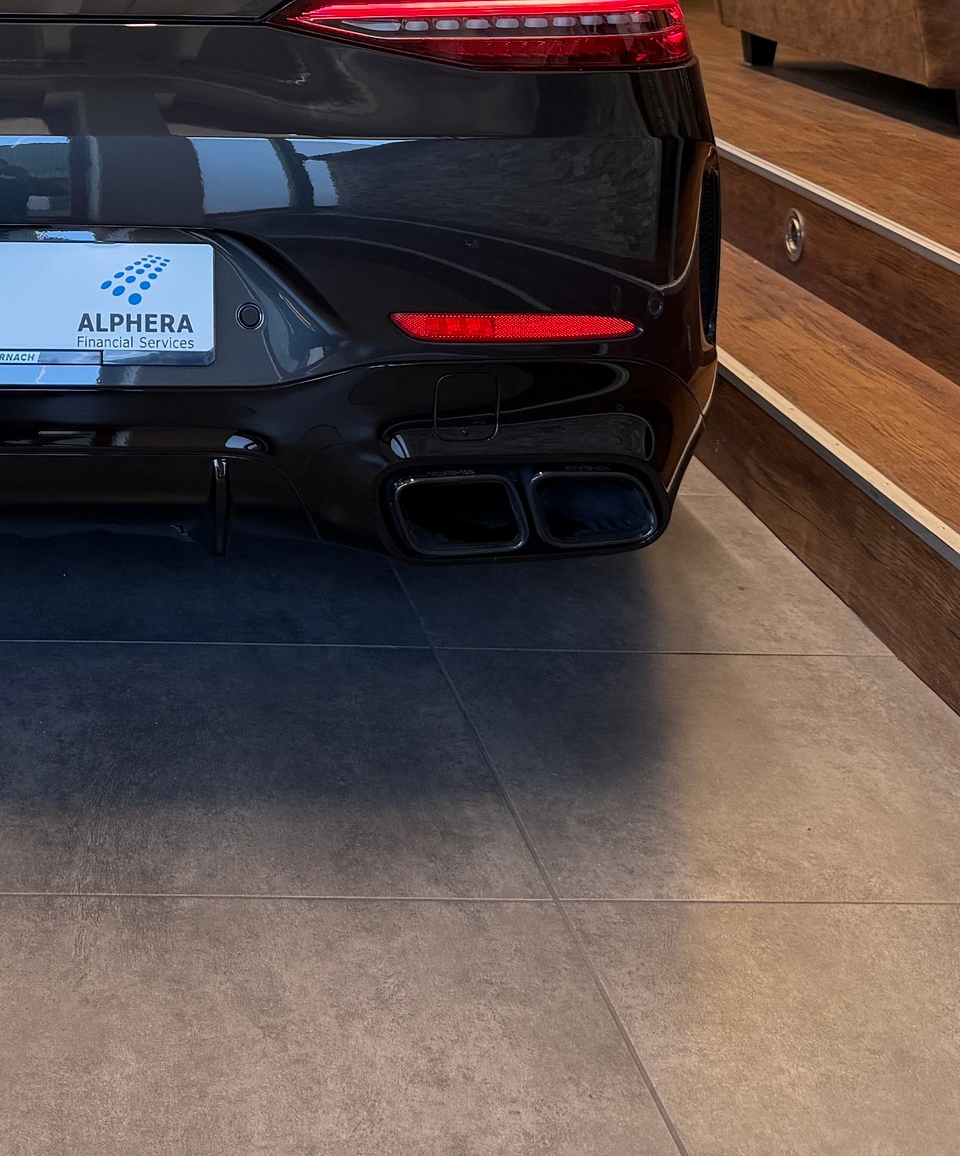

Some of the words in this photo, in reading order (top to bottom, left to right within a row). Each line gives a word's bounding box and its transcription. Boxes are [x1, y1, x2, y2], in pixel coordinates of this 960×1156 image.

[77, 313, 194, 333] ALPHERA
[77, 335, 134, 348] Financial
[139, 336, 195, 349] Services
